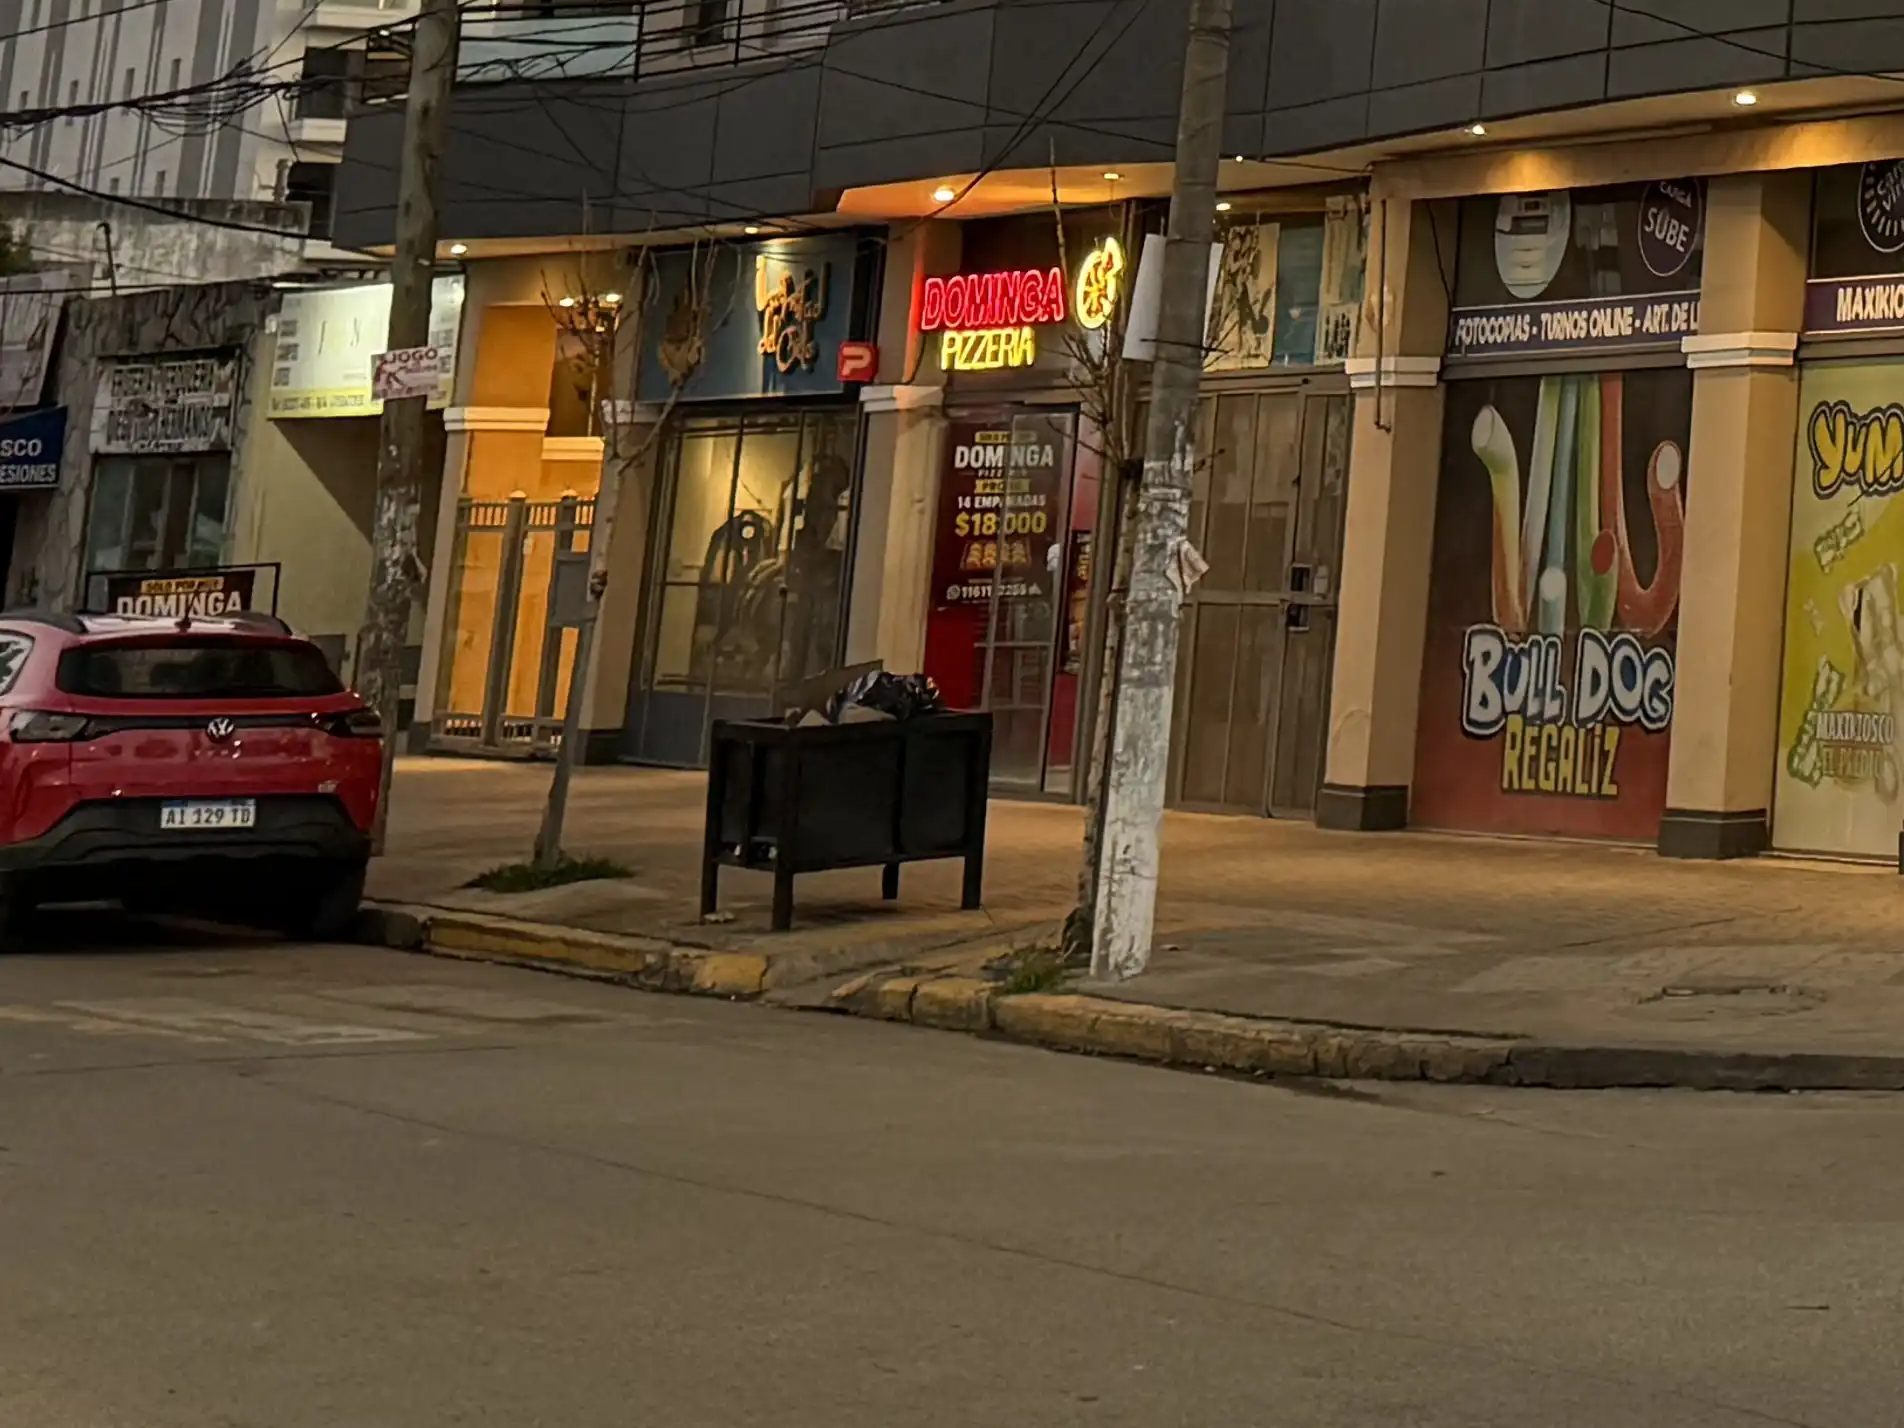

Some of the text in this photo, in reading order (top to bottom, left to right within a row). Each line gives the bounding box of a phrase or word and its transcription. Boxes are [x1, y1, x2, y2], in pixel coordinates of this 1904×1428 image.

[1644, 206, 1689, 253] SUBE
[921, 266, 1065, 330] DOMINGA
[1455, 312, 1532, 346] FOTOCOPIAS
[1540, 309, 1588, 341] TURNOS
[1589, 305, 1635, 338] ONLINE
[1642, 303, 1669, 336] ART.
[1671, 301, 1691, 332] DE
[941, 326, 1035, 371] PIZZERIA
[953, 444, 1054, 469] DOMNGA
[116, 591, 242, 617] DOMINGA
[166, 807, 185, 827] AI
[192, 805, 225, 827] 129
